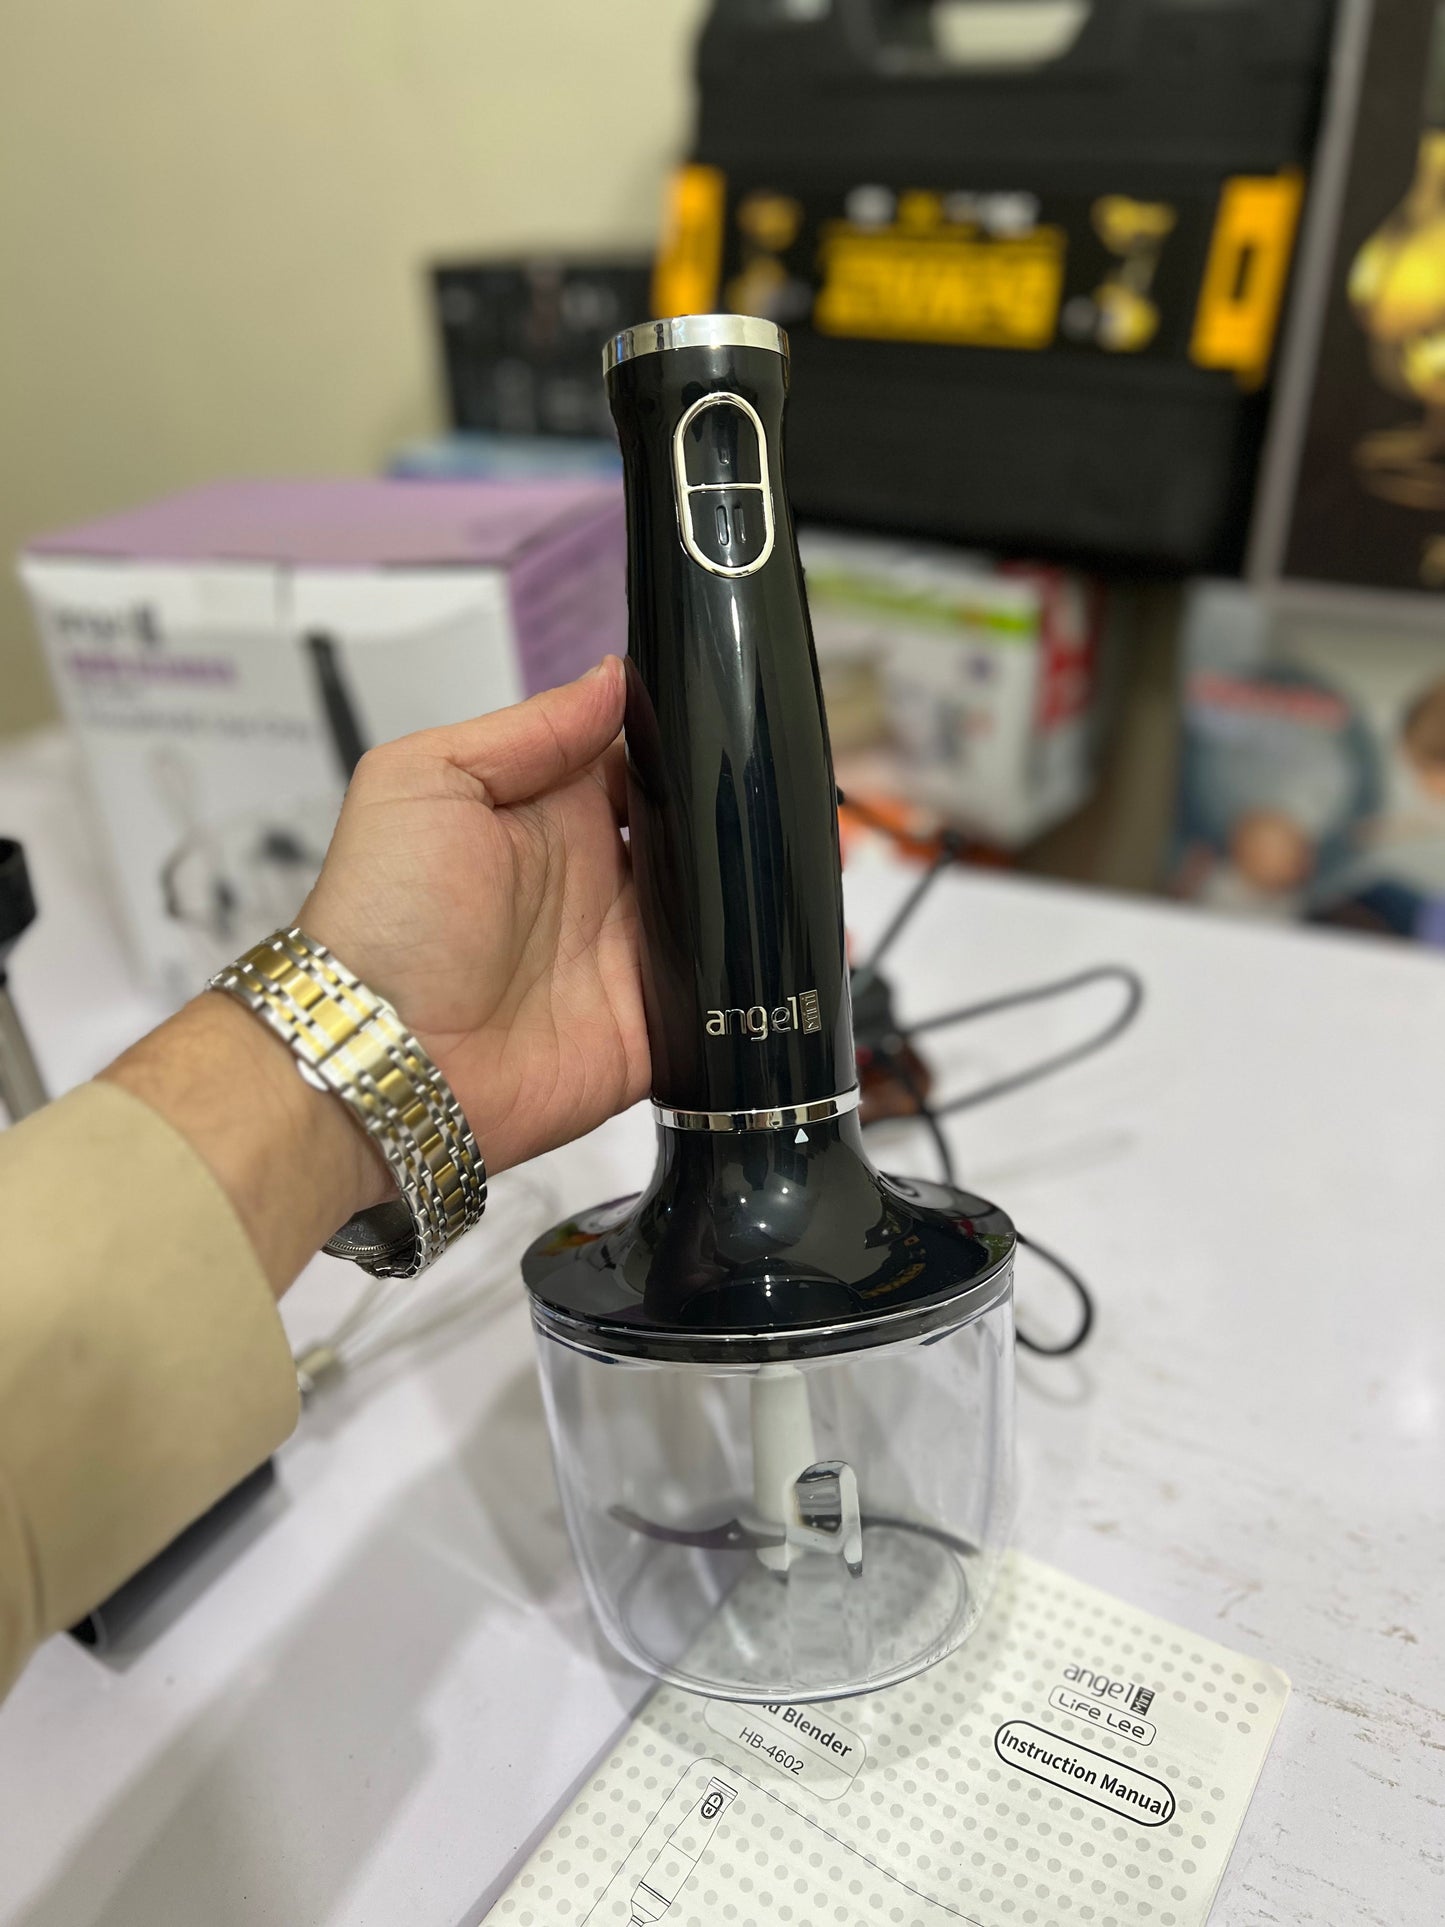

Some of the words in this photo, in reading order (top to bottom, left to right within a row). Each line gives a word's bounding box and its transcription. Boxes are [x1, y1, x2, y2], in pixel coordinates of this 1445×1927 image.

[706, 996, 799, 1041] angel
[799, 989, 821, 1034] Mini
[1063, 1662, 1135, 1703] angel
[1130, 1686, 1155, 1716] Mini
[738, 1726, 804, 1776] HB-4602
[782, 1706, 852, 1757] Blender
[1106, 1713, 1145, 1739] Lee
[1001, 1729, 1097, 1785] Instruction
[1099, 1773, 1170, 1818] Manual
